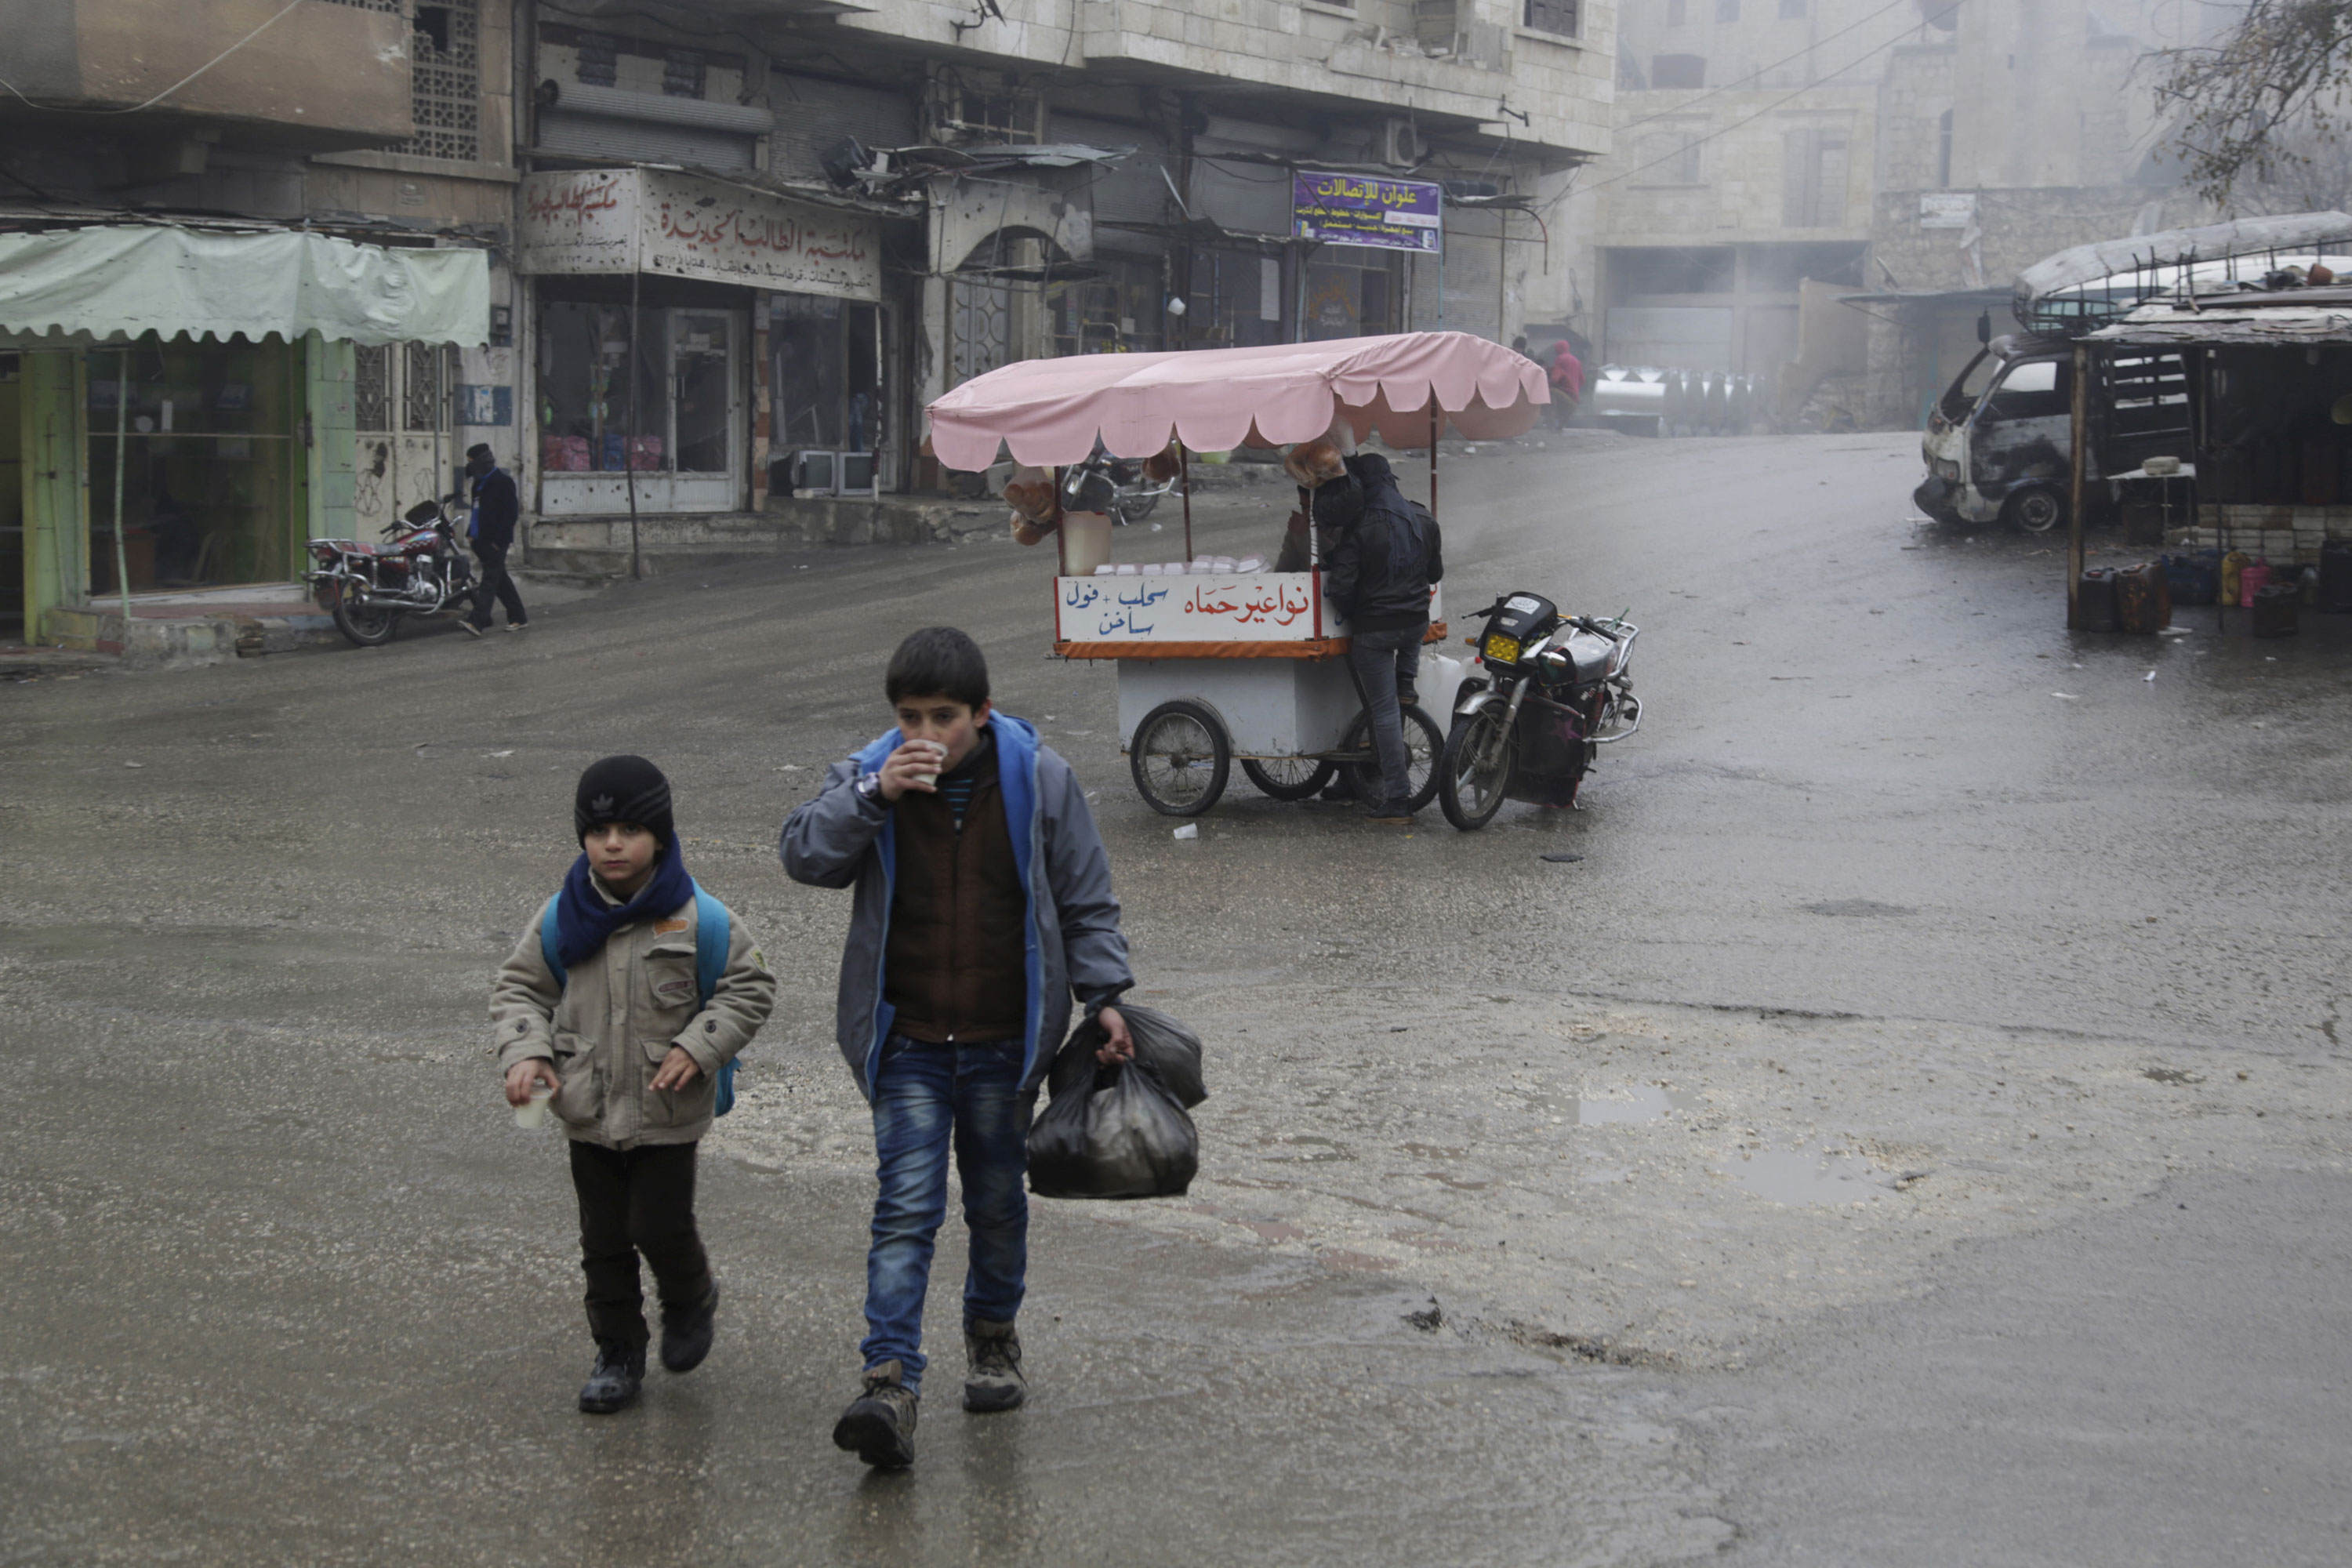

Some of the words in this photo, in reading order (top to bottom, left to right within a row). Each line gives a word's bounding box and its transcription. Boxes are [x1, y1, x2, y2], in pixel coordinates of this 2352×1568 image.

[1317, 178, 1379, 206] للإتصالات
[1381, 184, 1417, 209] علوان
[738, 216, 802, 258] الطالب
[804, 227, 866, 264] مكتبة
[1066, 583, 1099, 608] فول
[1118, 582, 1169, 610] سحلب
[1234, 583, 1309, 626] نواعير
[1098, 609, 1155, 636] ساخن
